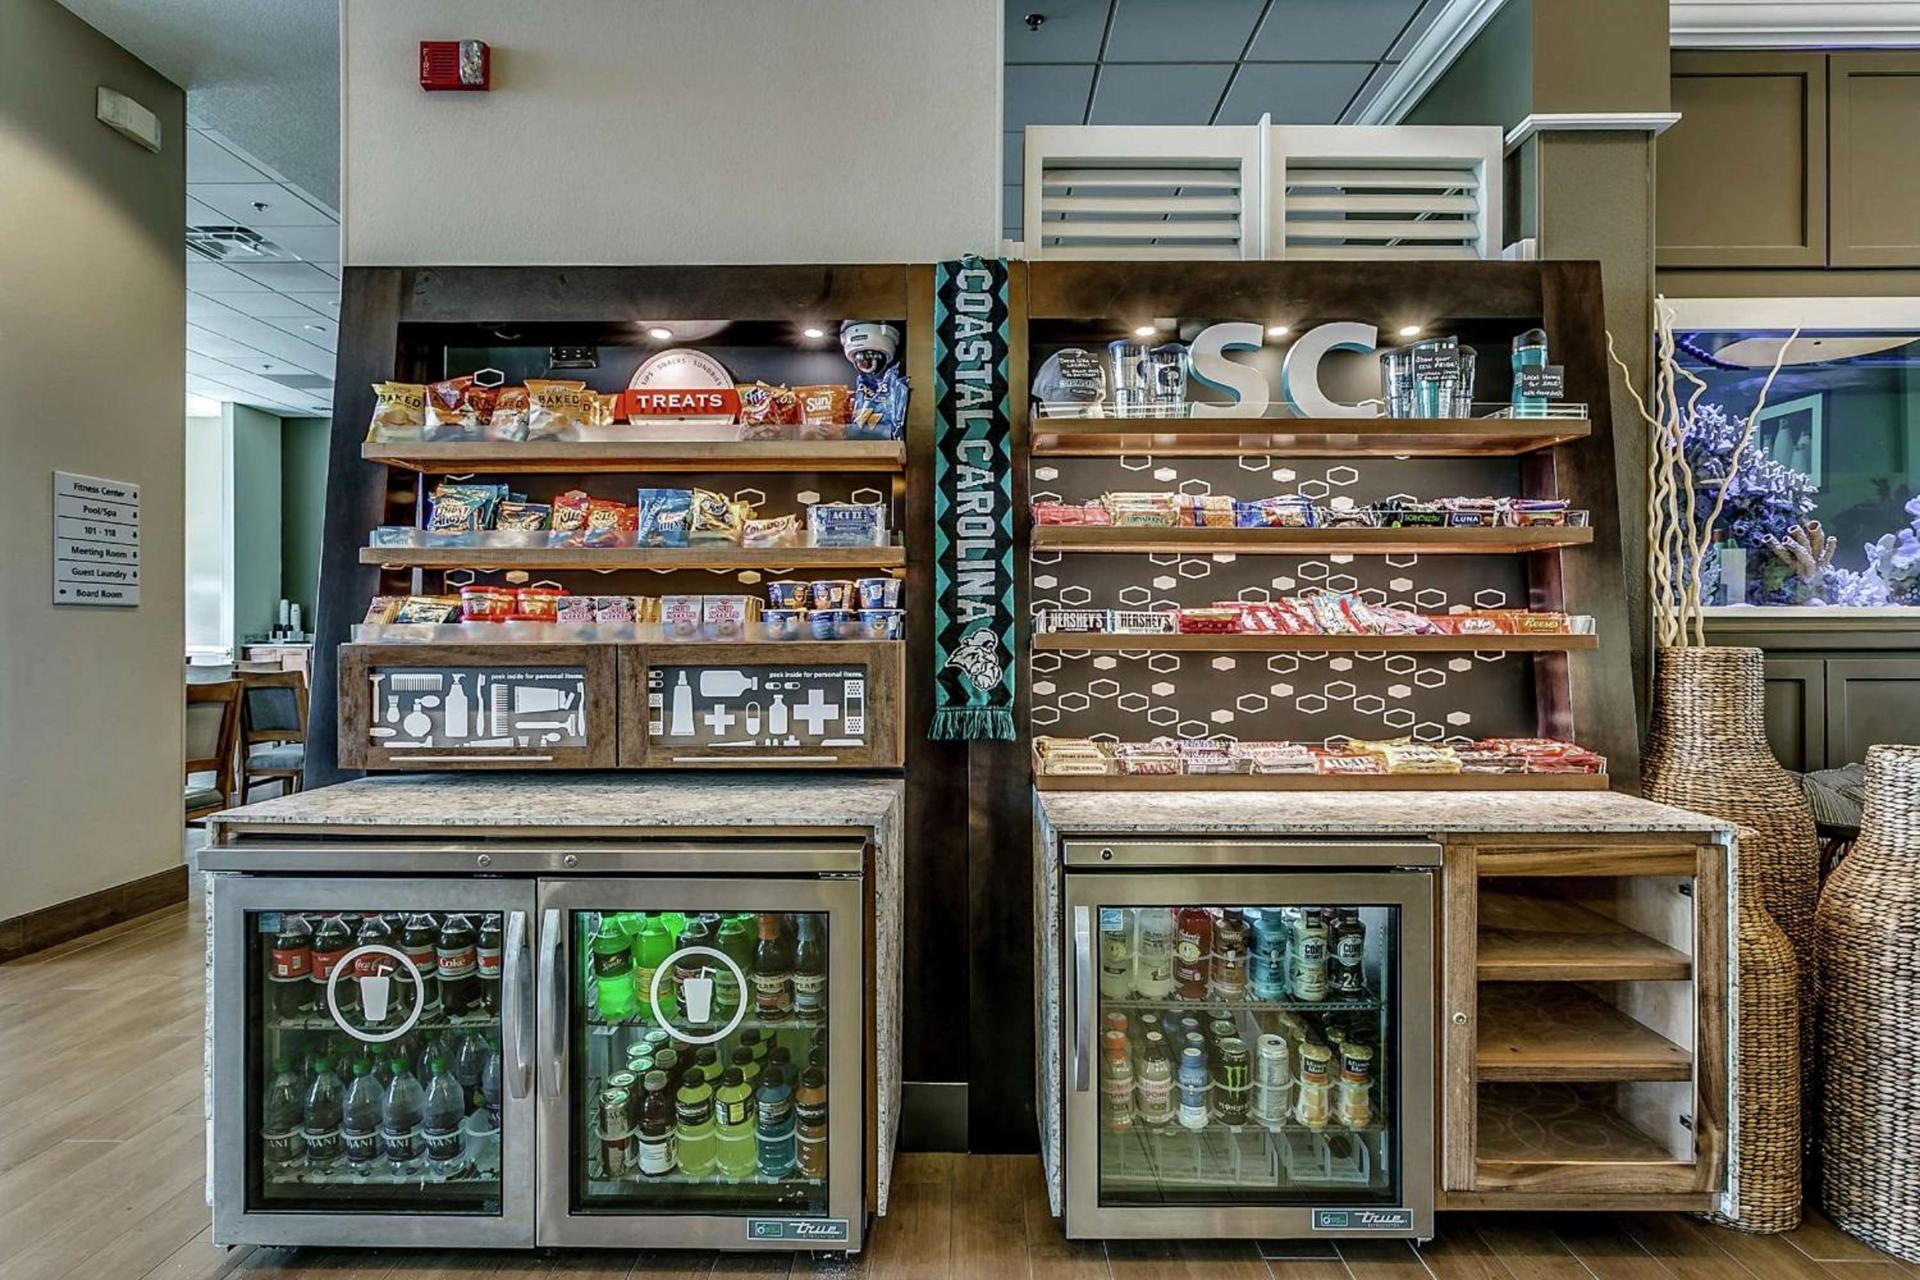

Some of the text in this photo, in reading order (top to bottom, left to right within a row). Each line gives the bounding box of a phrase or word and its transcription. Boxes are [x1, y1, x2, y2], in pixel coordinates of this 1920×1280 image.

[657, 358, 686, 370] SNACKS
[693, 359, 723, 387] SUNDRIES
[1189, 321, 1379, 419] SC
[379, 393, 421, 409] BAKED
[538, 395, 580, 405] BAKED
[637, 393, 723, 408] TREATS
[955, 269, 996, 624] COASTAL CAROLINA
[73, 482, 126, 498] Fitness Center
[83, 505, 117, 517] Pool/Spa
[84, 526, 97, 535] 101
[104, 528, 116, 537] 118
[71, 546, 127, 559] Meeting Room
[71, 567, 127, 580] Guest Laundry
[76, 589, 123, 598] Board Room
[1051, 612, 1103, 627] HERSHEY'S
[1121, 613, 1170, 628] HERSHEY'S
[535, 672, 563, 680] personal
[440, 957, 466, 968] Coke
